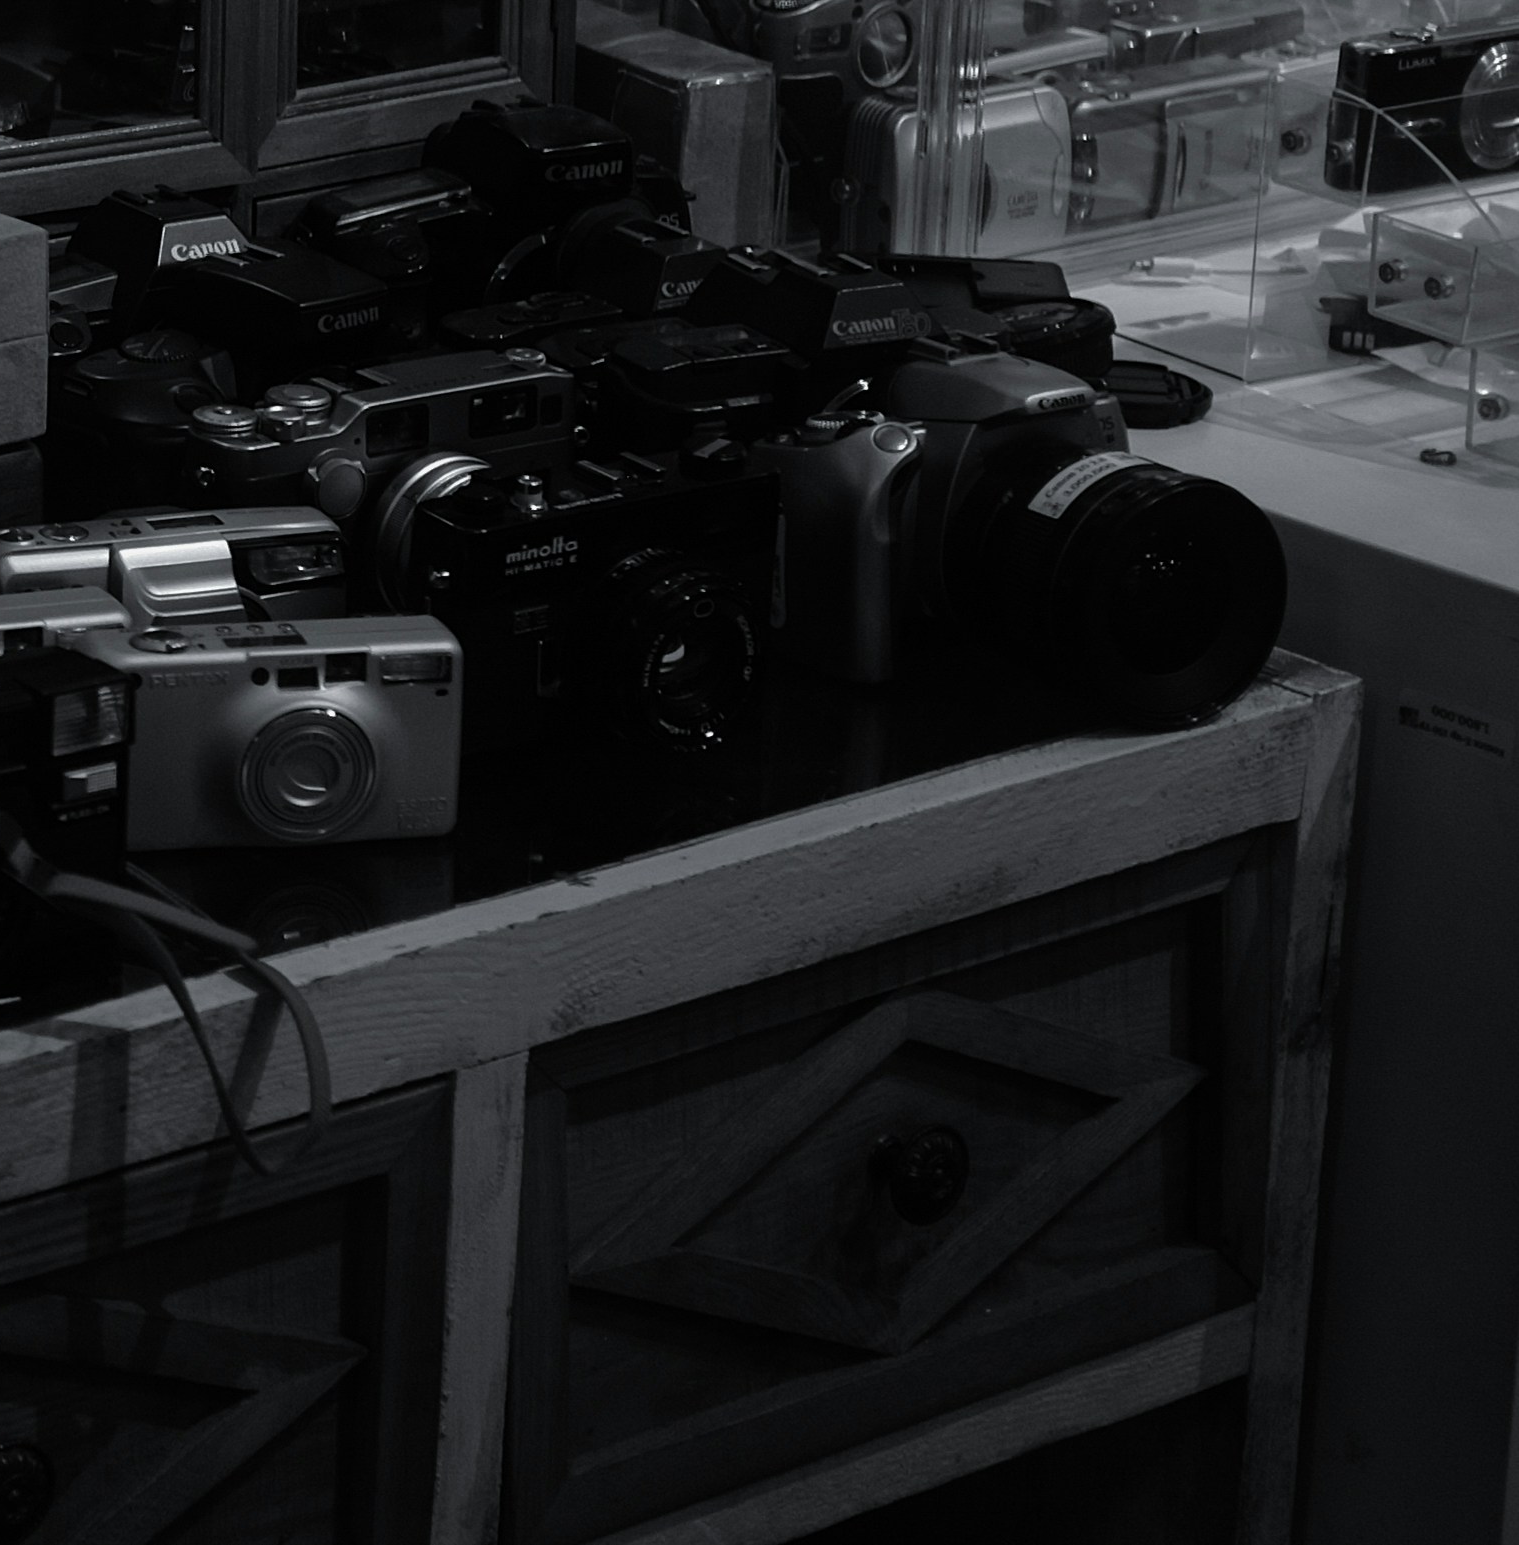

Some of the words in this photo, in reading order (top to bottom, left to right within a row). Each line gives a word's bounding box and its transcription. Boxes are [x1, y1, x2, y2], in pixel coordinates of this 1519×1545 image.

[545, 159, 624, 183] Canon
[170, 238, 241, 262] Canon
[317, 305, 380, 334] Canon
[832, 316, 896, 337] Canon
[1038, 393, 1087, 411] Canon
[505, 536, 579, 565] minolta
[150, 671, 230, 689] PENTAX
